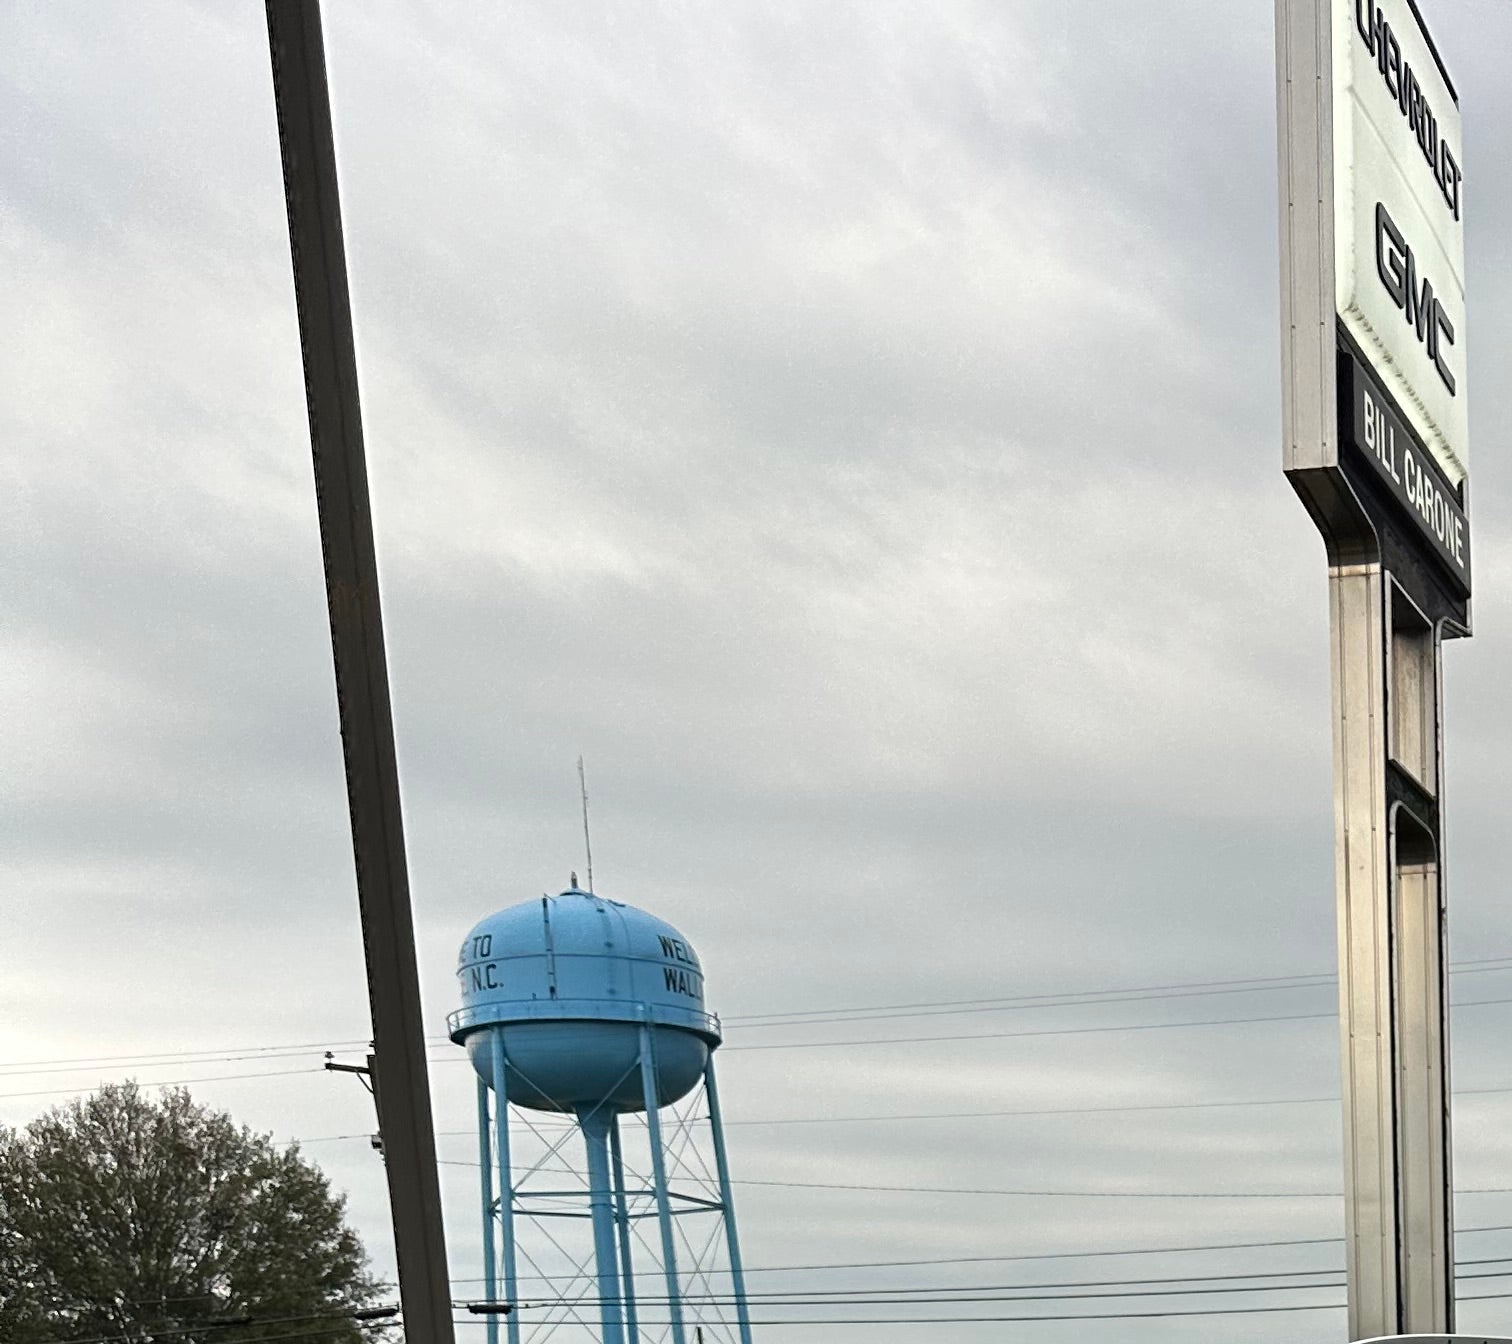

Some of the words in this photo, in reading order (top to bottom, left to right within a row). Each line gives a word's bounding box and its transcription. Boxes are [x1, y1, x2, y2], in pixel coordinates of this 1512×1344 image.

[1374, 201, 1456, 397] GMC
[1363, 389, 1400, 486] BILL
[1404, 448, 1465, 569] CARONE
